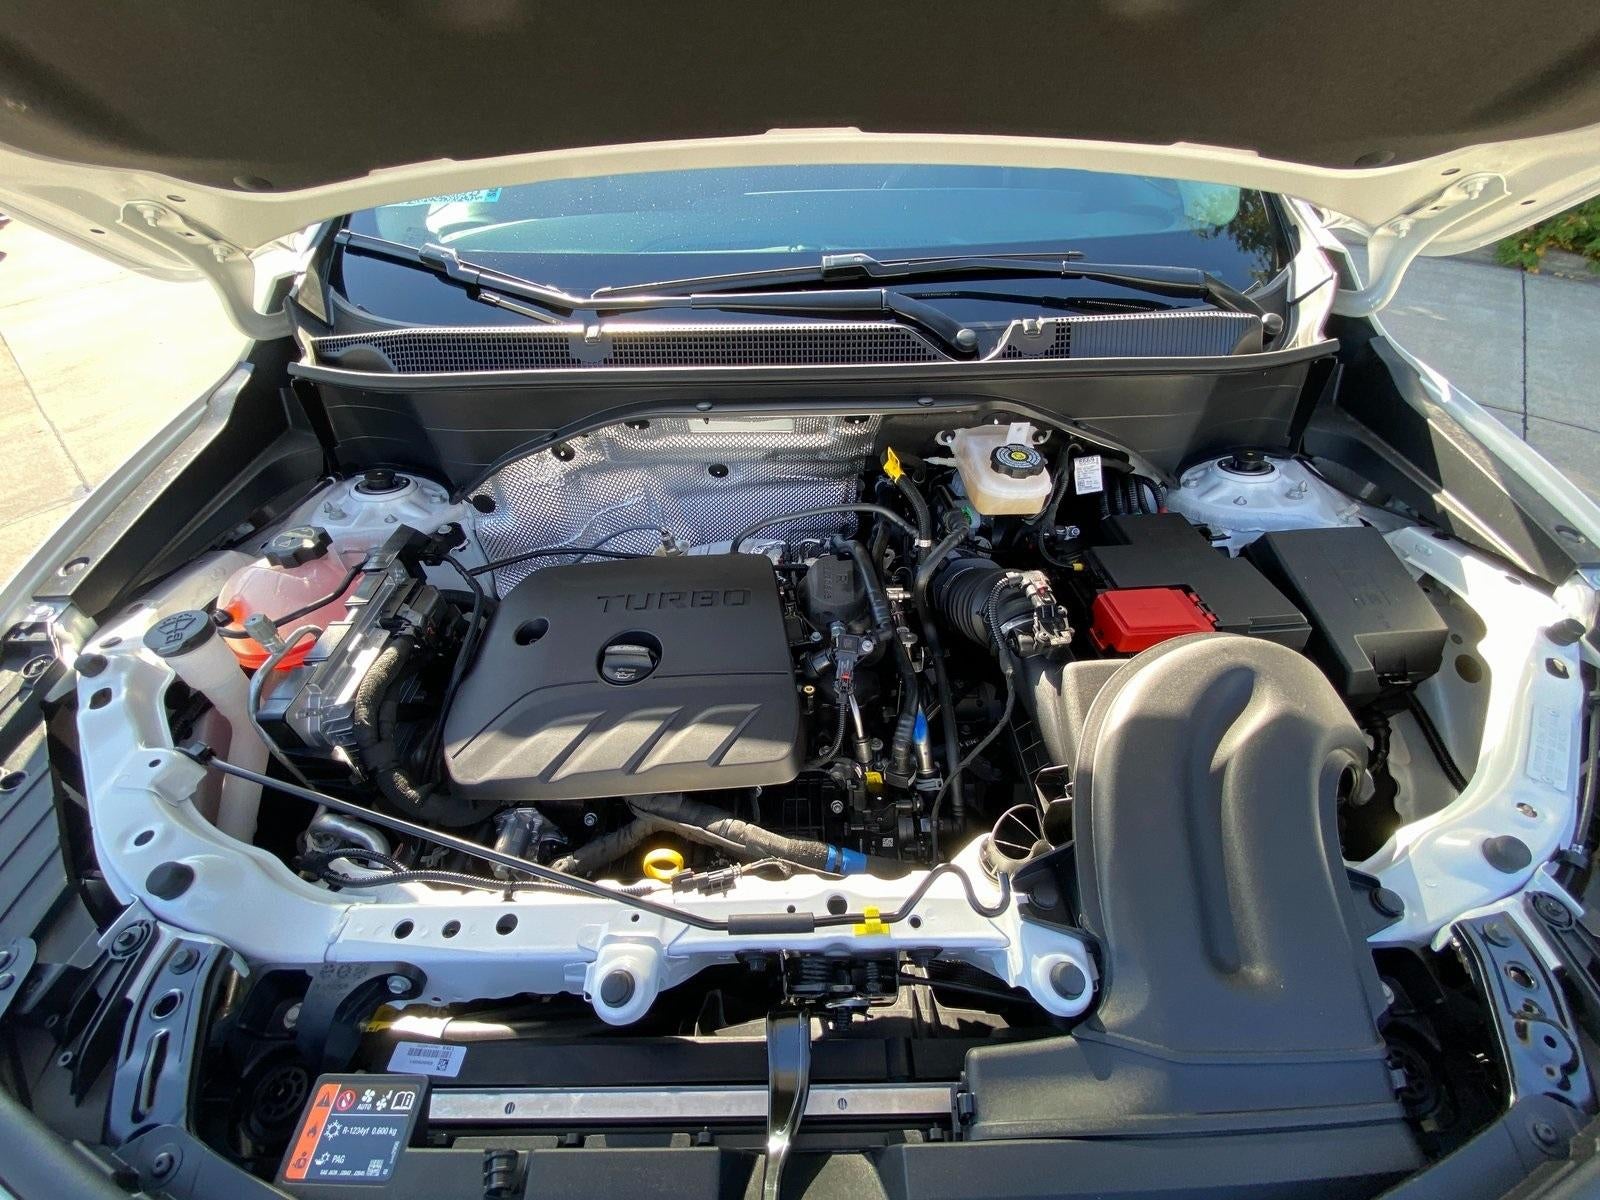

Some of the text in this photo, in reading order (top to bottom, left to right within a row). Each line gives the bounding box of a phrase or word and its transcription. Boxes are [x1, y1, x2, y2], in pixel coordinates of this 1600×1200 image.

[597, 590, 750, 613] TURBO
[342, 1126, 370, 1136] R-1234yf
[389, 1127, 397, 1136] kg
[332, 1155, 346, 1164] PAG
